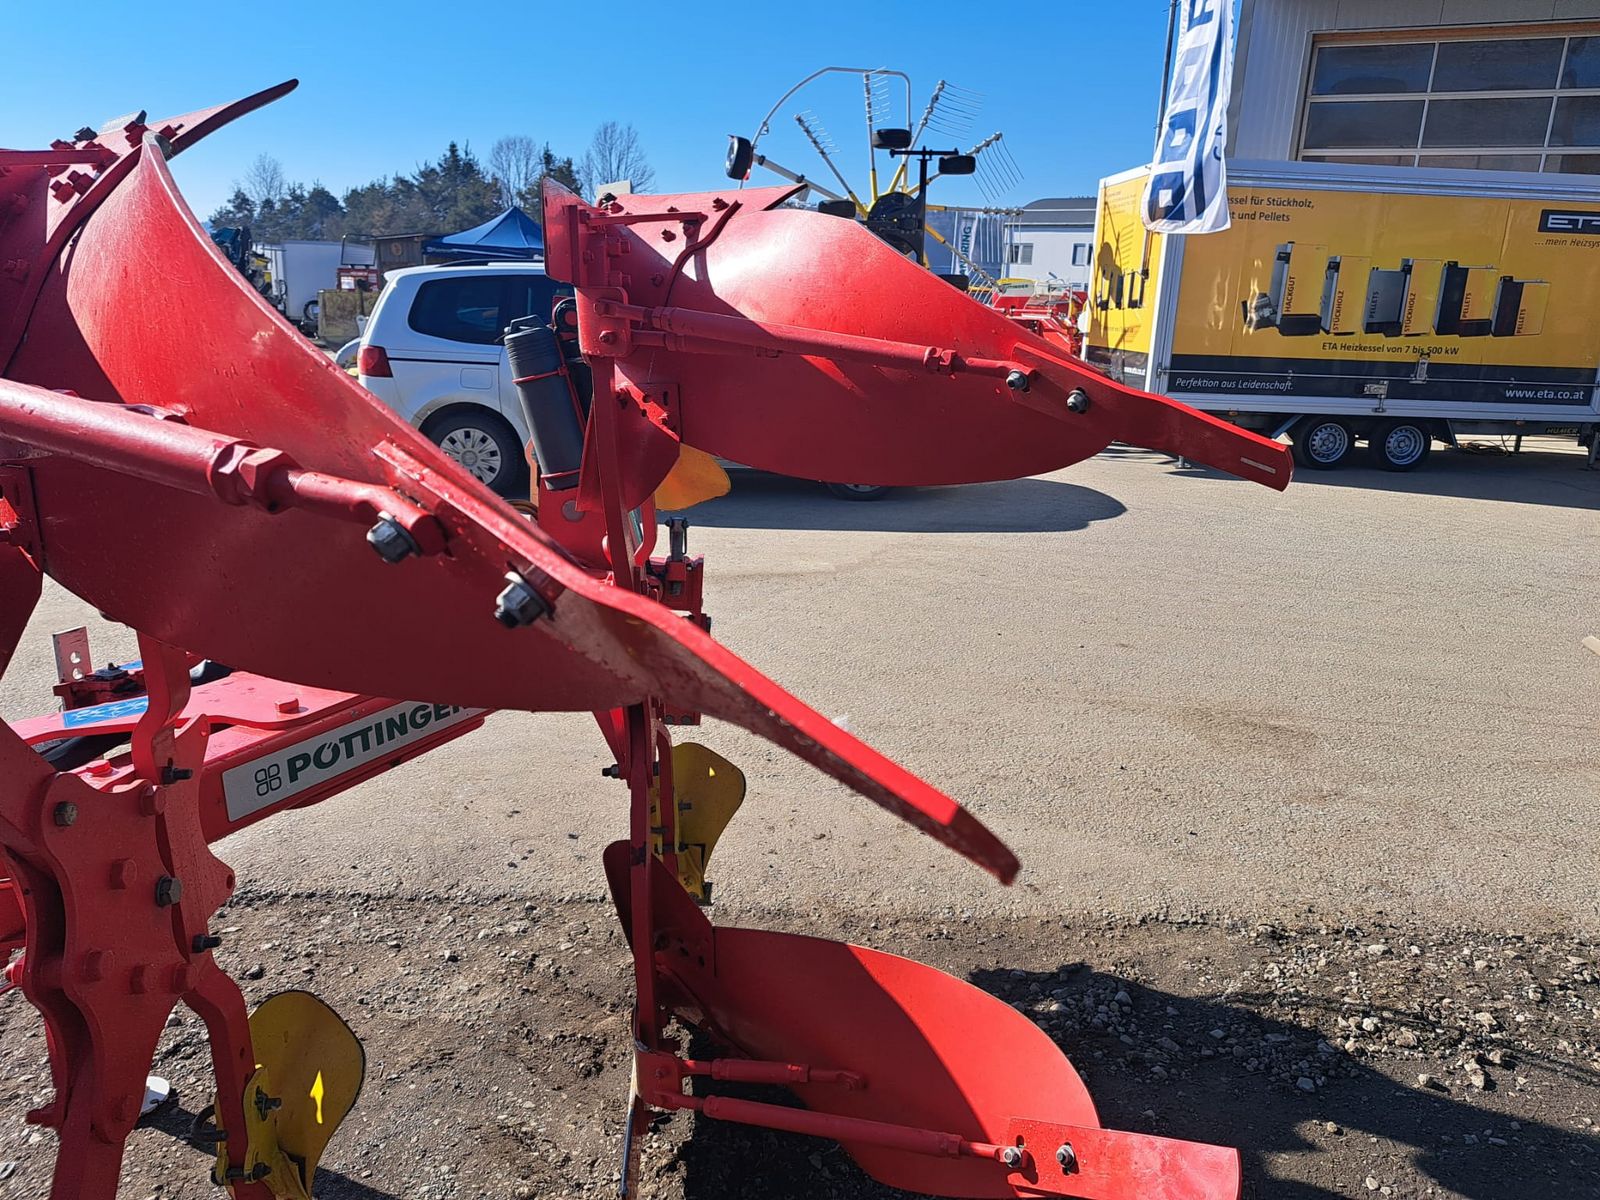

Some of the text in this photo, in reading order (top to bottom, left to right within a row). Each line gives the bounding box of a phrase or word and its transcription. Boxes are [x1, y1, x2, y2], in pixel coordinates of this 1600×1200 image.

[1250, 196, 1264, 206] für
[1266, 197, 1315, 210] Stückholz,
[1238, 210, 1256, 221] und
[1258, 212, 1291, 222] Pellets
[1284, 276, 1296, 312] HACKGUT
[1332, 290, 1345, 331] STÜCKHOLZ
[1368, 290, 1380, 319] PELLETS
[1462, 292, 1472, 318] PELLETS
[1516, 308, 1526, 334] PELLETS
[1322, 342, 1460, 355] ETA Heizkessel von 7 bis 500 kW
[1175, 377, 1294, 392] Perfektion aus Leidenschaft.
[1504, 389, 1585, 400] www.eta.co.at
